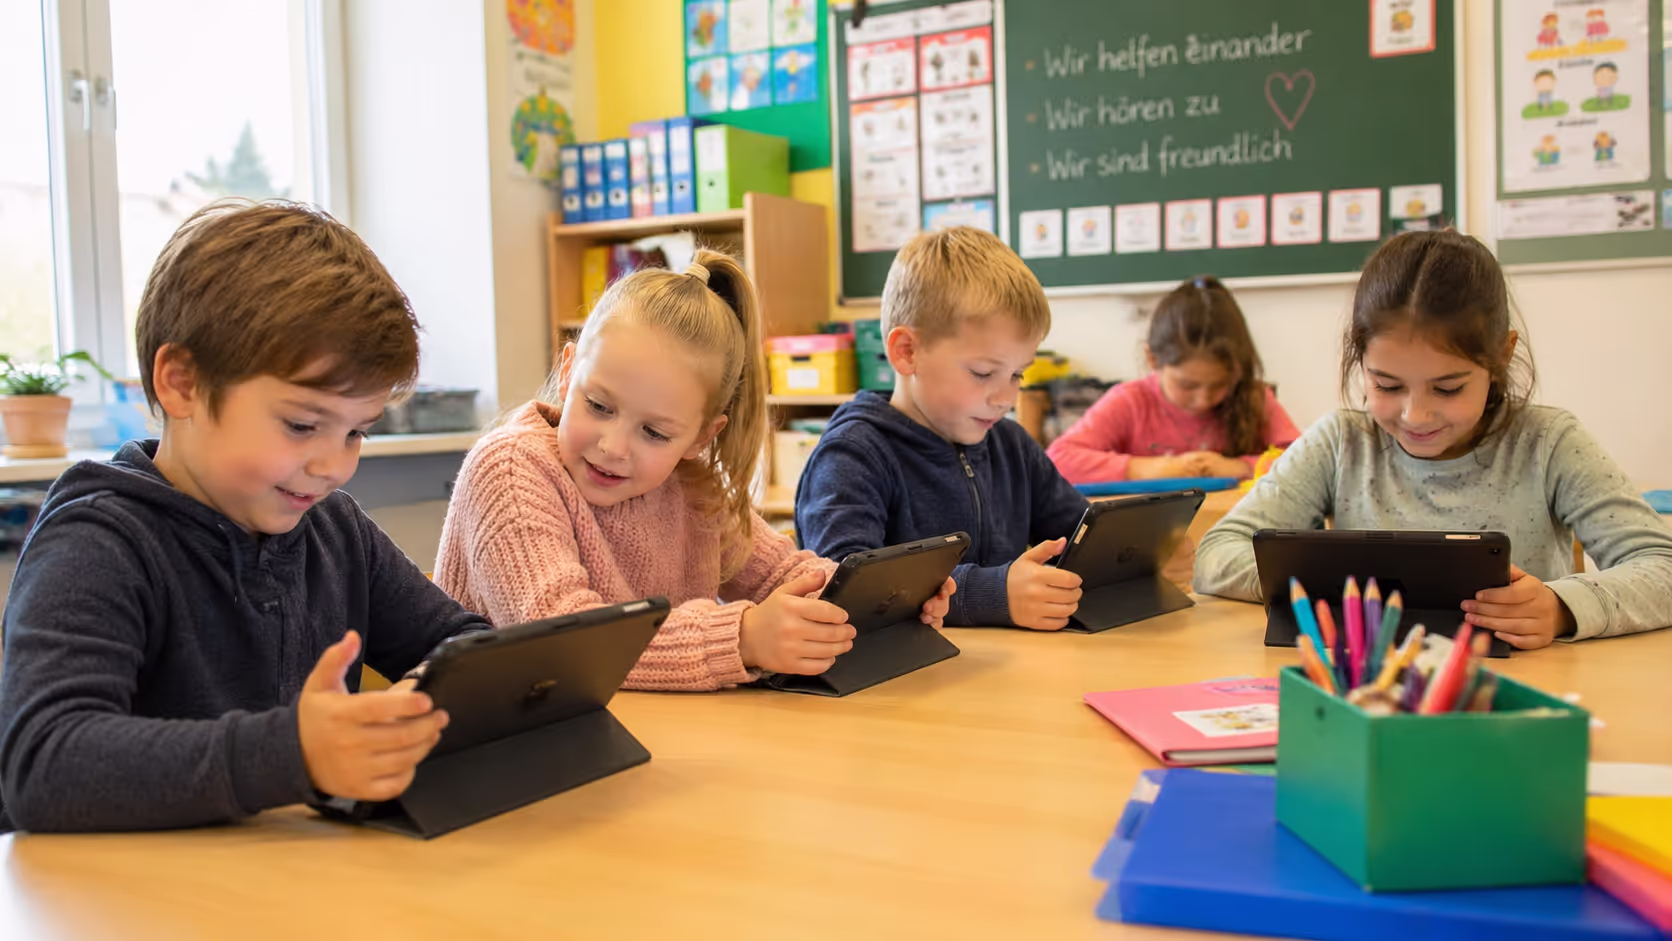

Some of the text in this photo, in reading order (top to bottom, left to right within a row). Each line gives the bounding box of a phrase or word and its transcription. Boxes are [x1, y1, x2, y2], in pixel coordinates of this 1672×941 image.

[1043, 45, 1090, 78] Wir
[1098, 33, 1179, 79] helfen
[1045, 95, 1091, 130] Wir
[1184, 95, 1221, 117] zu
[1046, 127, 1292, 181] Wir sind freundlich
